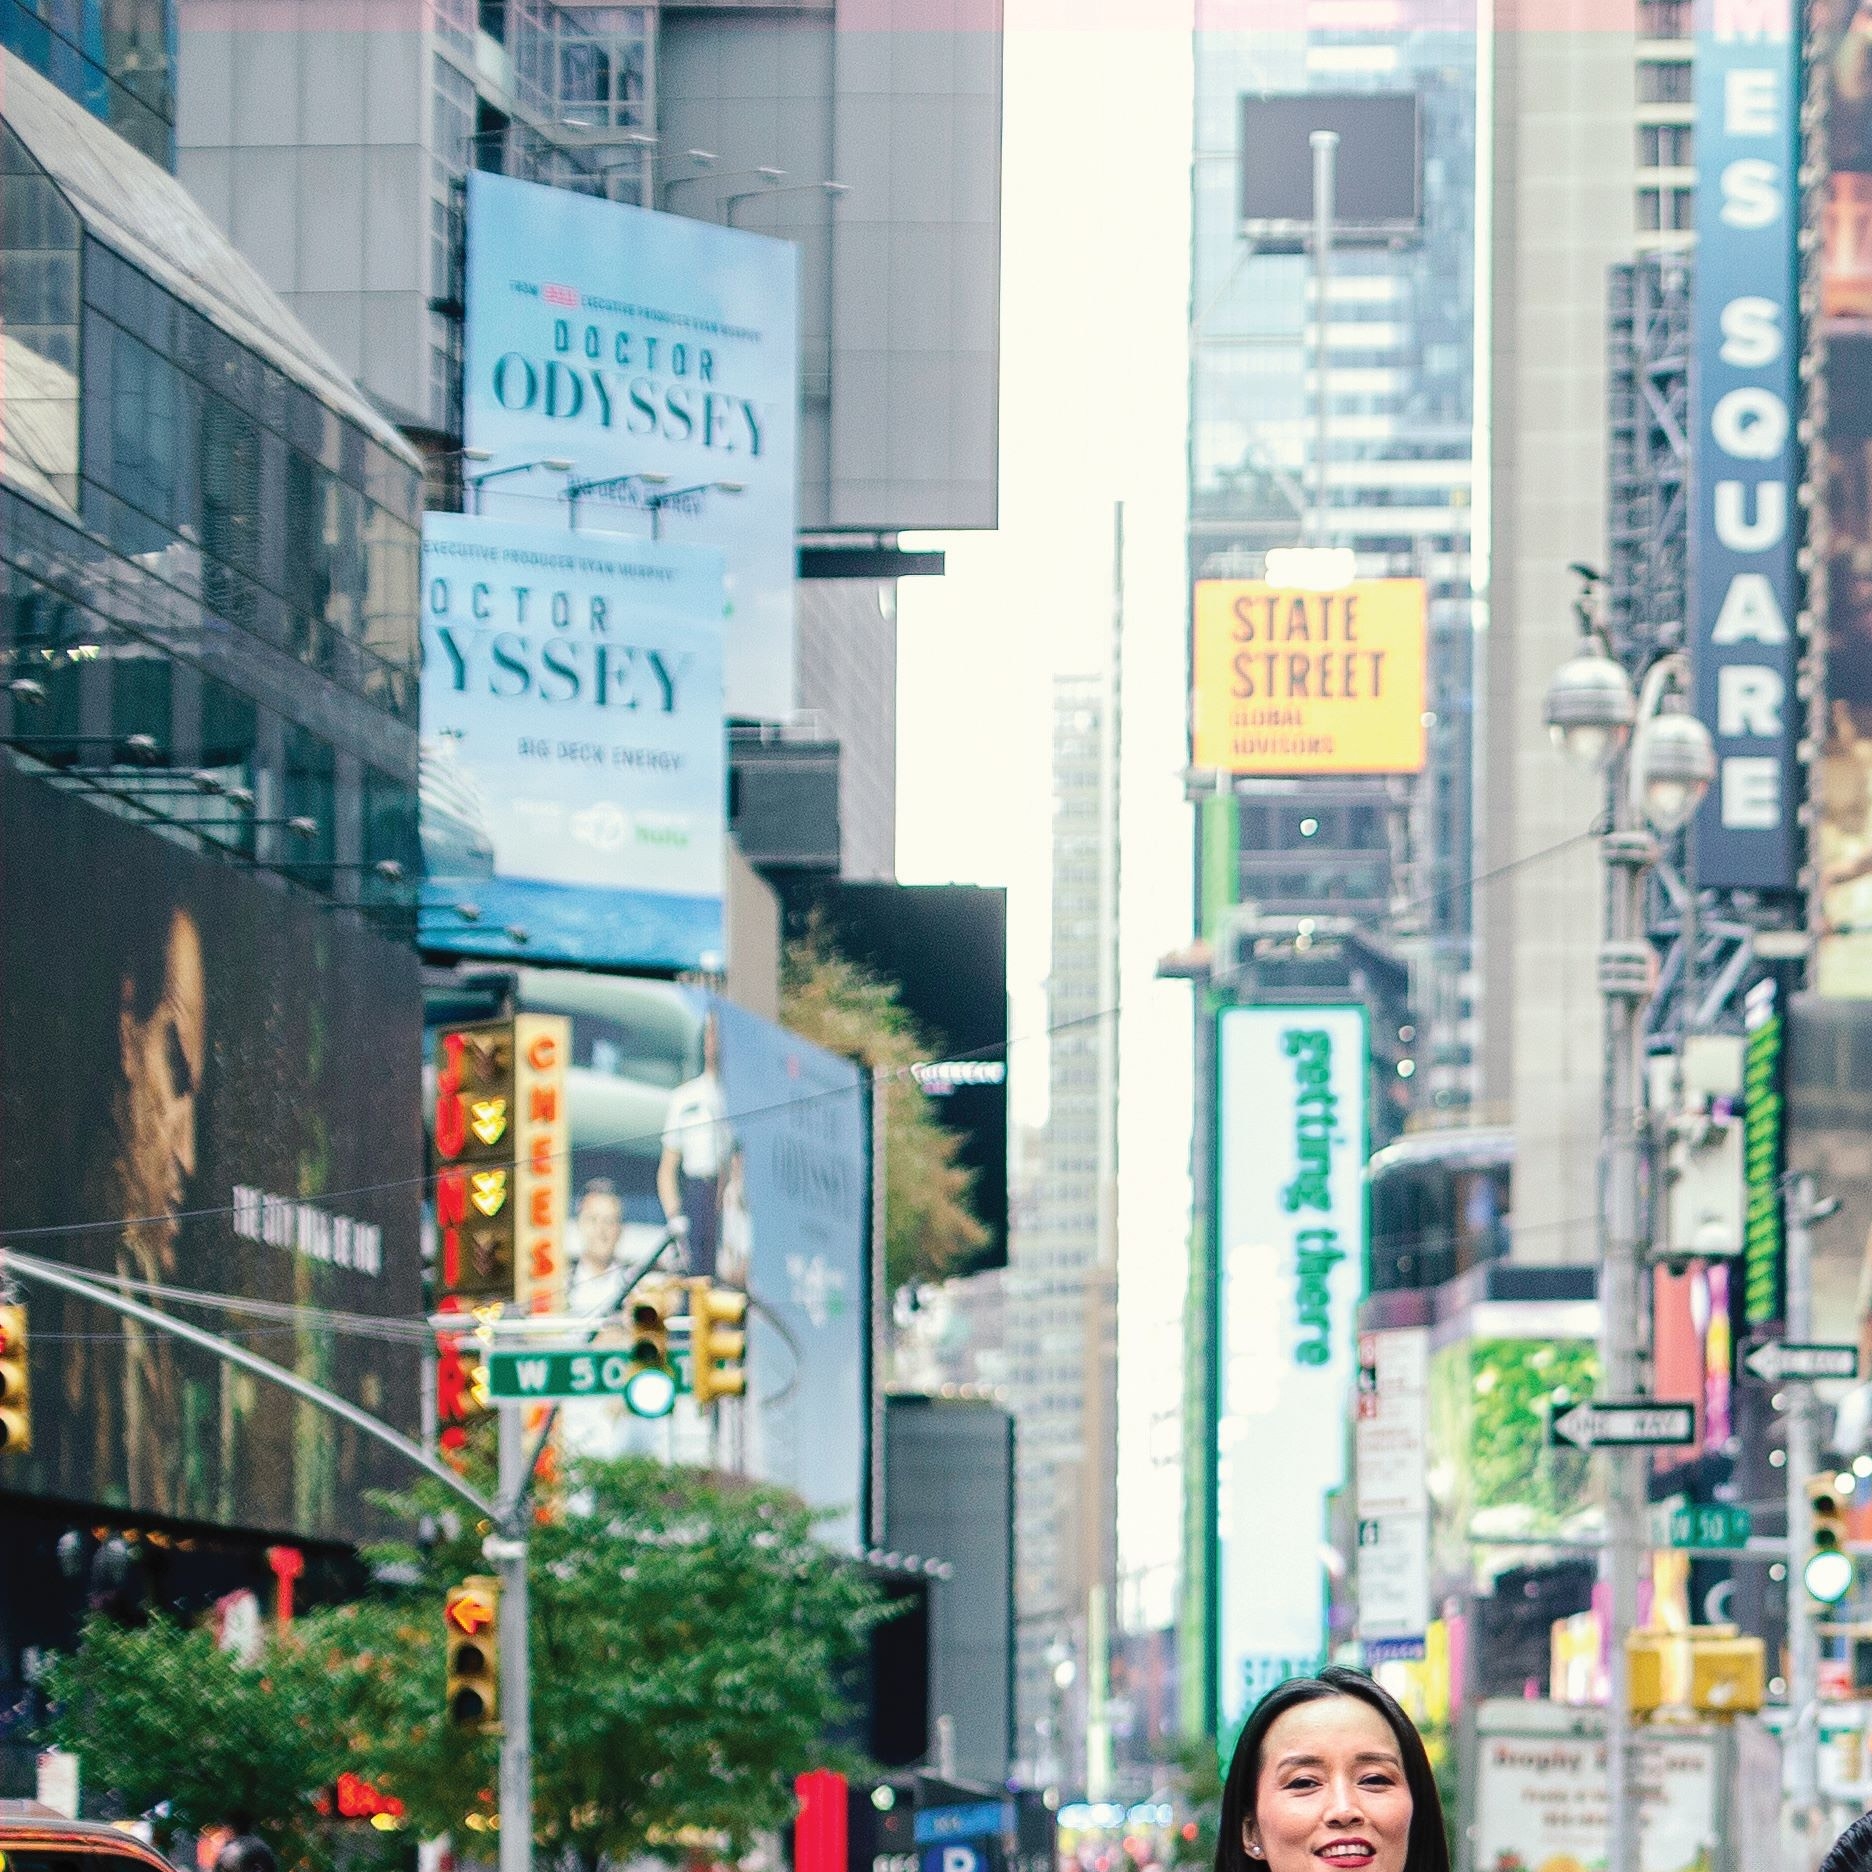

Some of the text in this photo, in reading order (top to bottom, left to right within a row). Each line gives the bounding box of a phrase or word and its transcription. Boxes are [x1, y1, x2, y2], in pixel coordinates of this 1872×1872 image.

[555, 318, 714, 384] DOCTOR
[491, 350, 768, 456] ODYSSEY
[1710, 295, 1791, 831] SQUARE
[1231, 596, 1358, 642] STATE
[1231, 650, 1386, 699] STREET
[1284, 1029, 1346, 1365] getting there
[515, 1358, 548, 1391] W
[569, 1356, 632, 1392] 50
